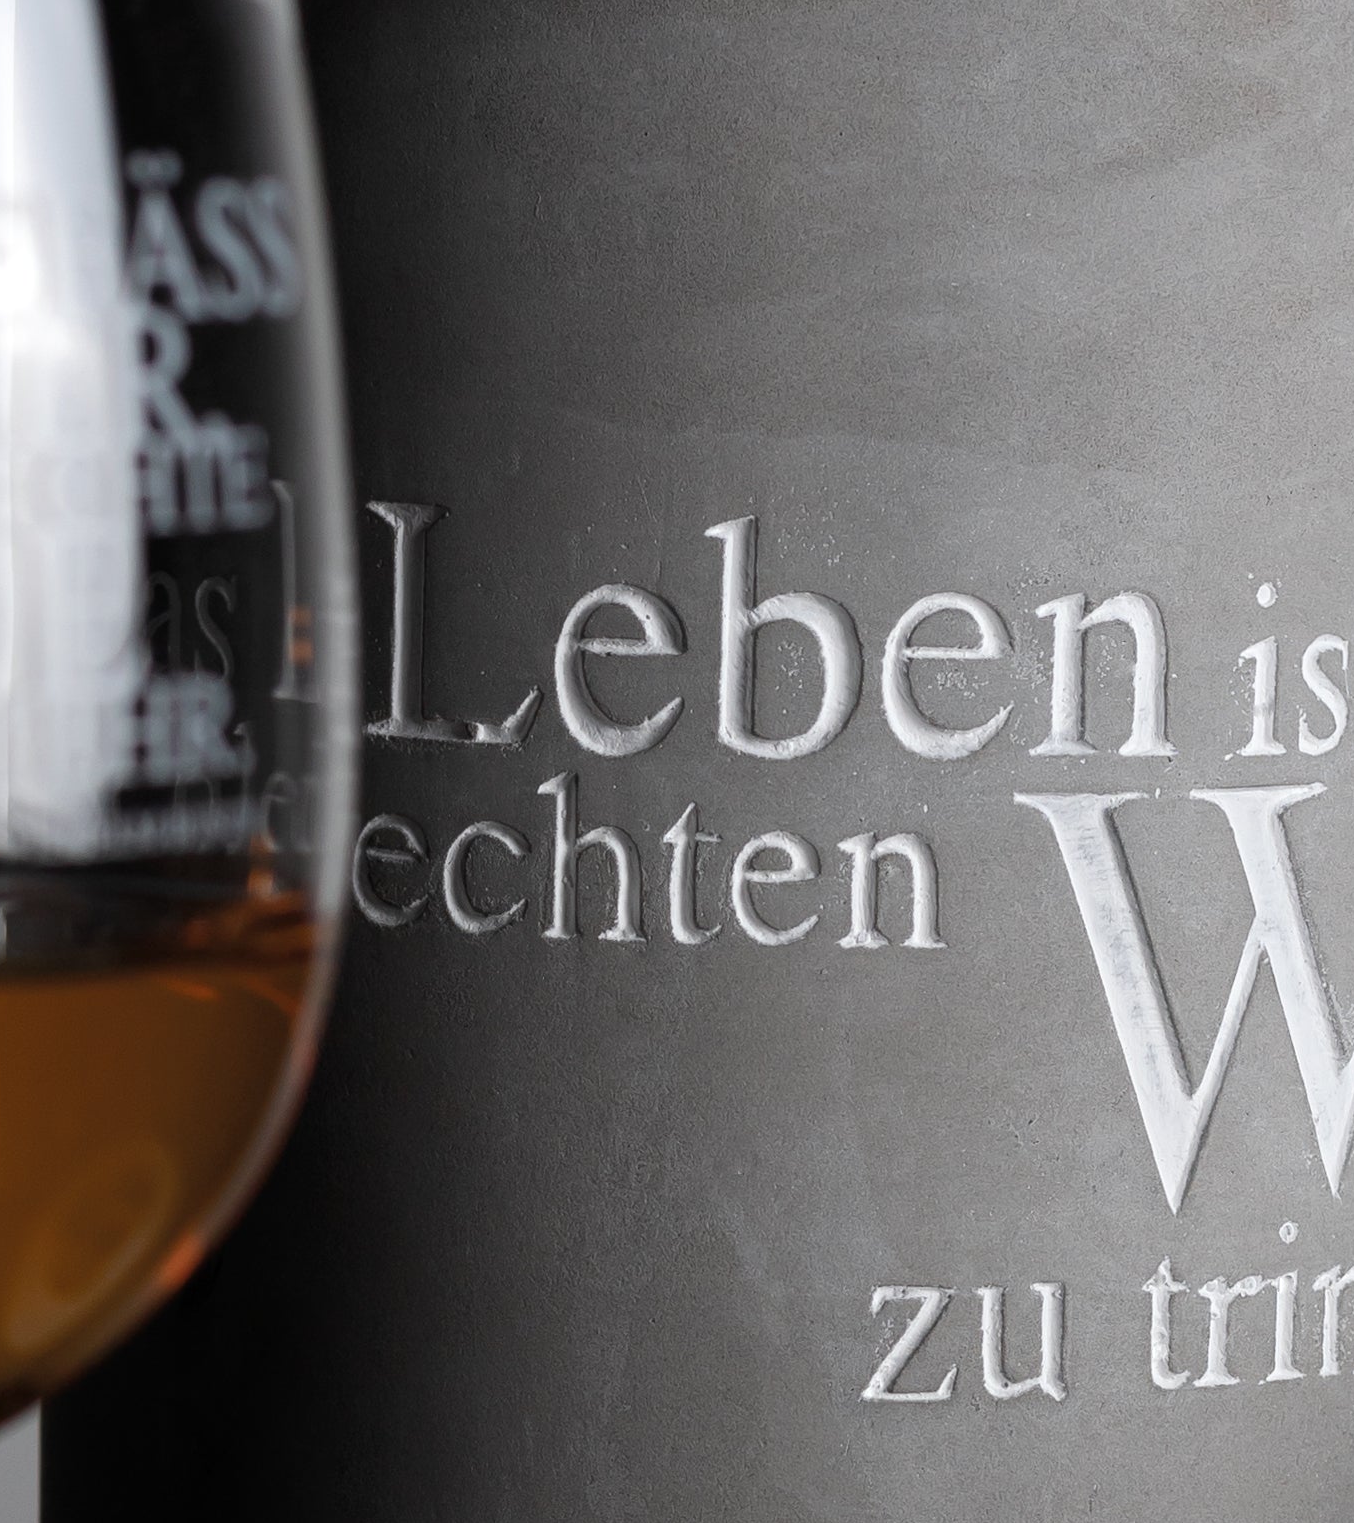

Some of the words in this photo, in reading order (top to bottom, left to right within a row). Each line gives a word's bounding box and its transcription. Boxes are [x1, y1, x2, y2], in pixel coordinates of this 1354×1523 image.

[365, 499, 1177, 762] Leben
[351, 771, 949, 950] echten
[860, 1283, 1067, 1404] zu
